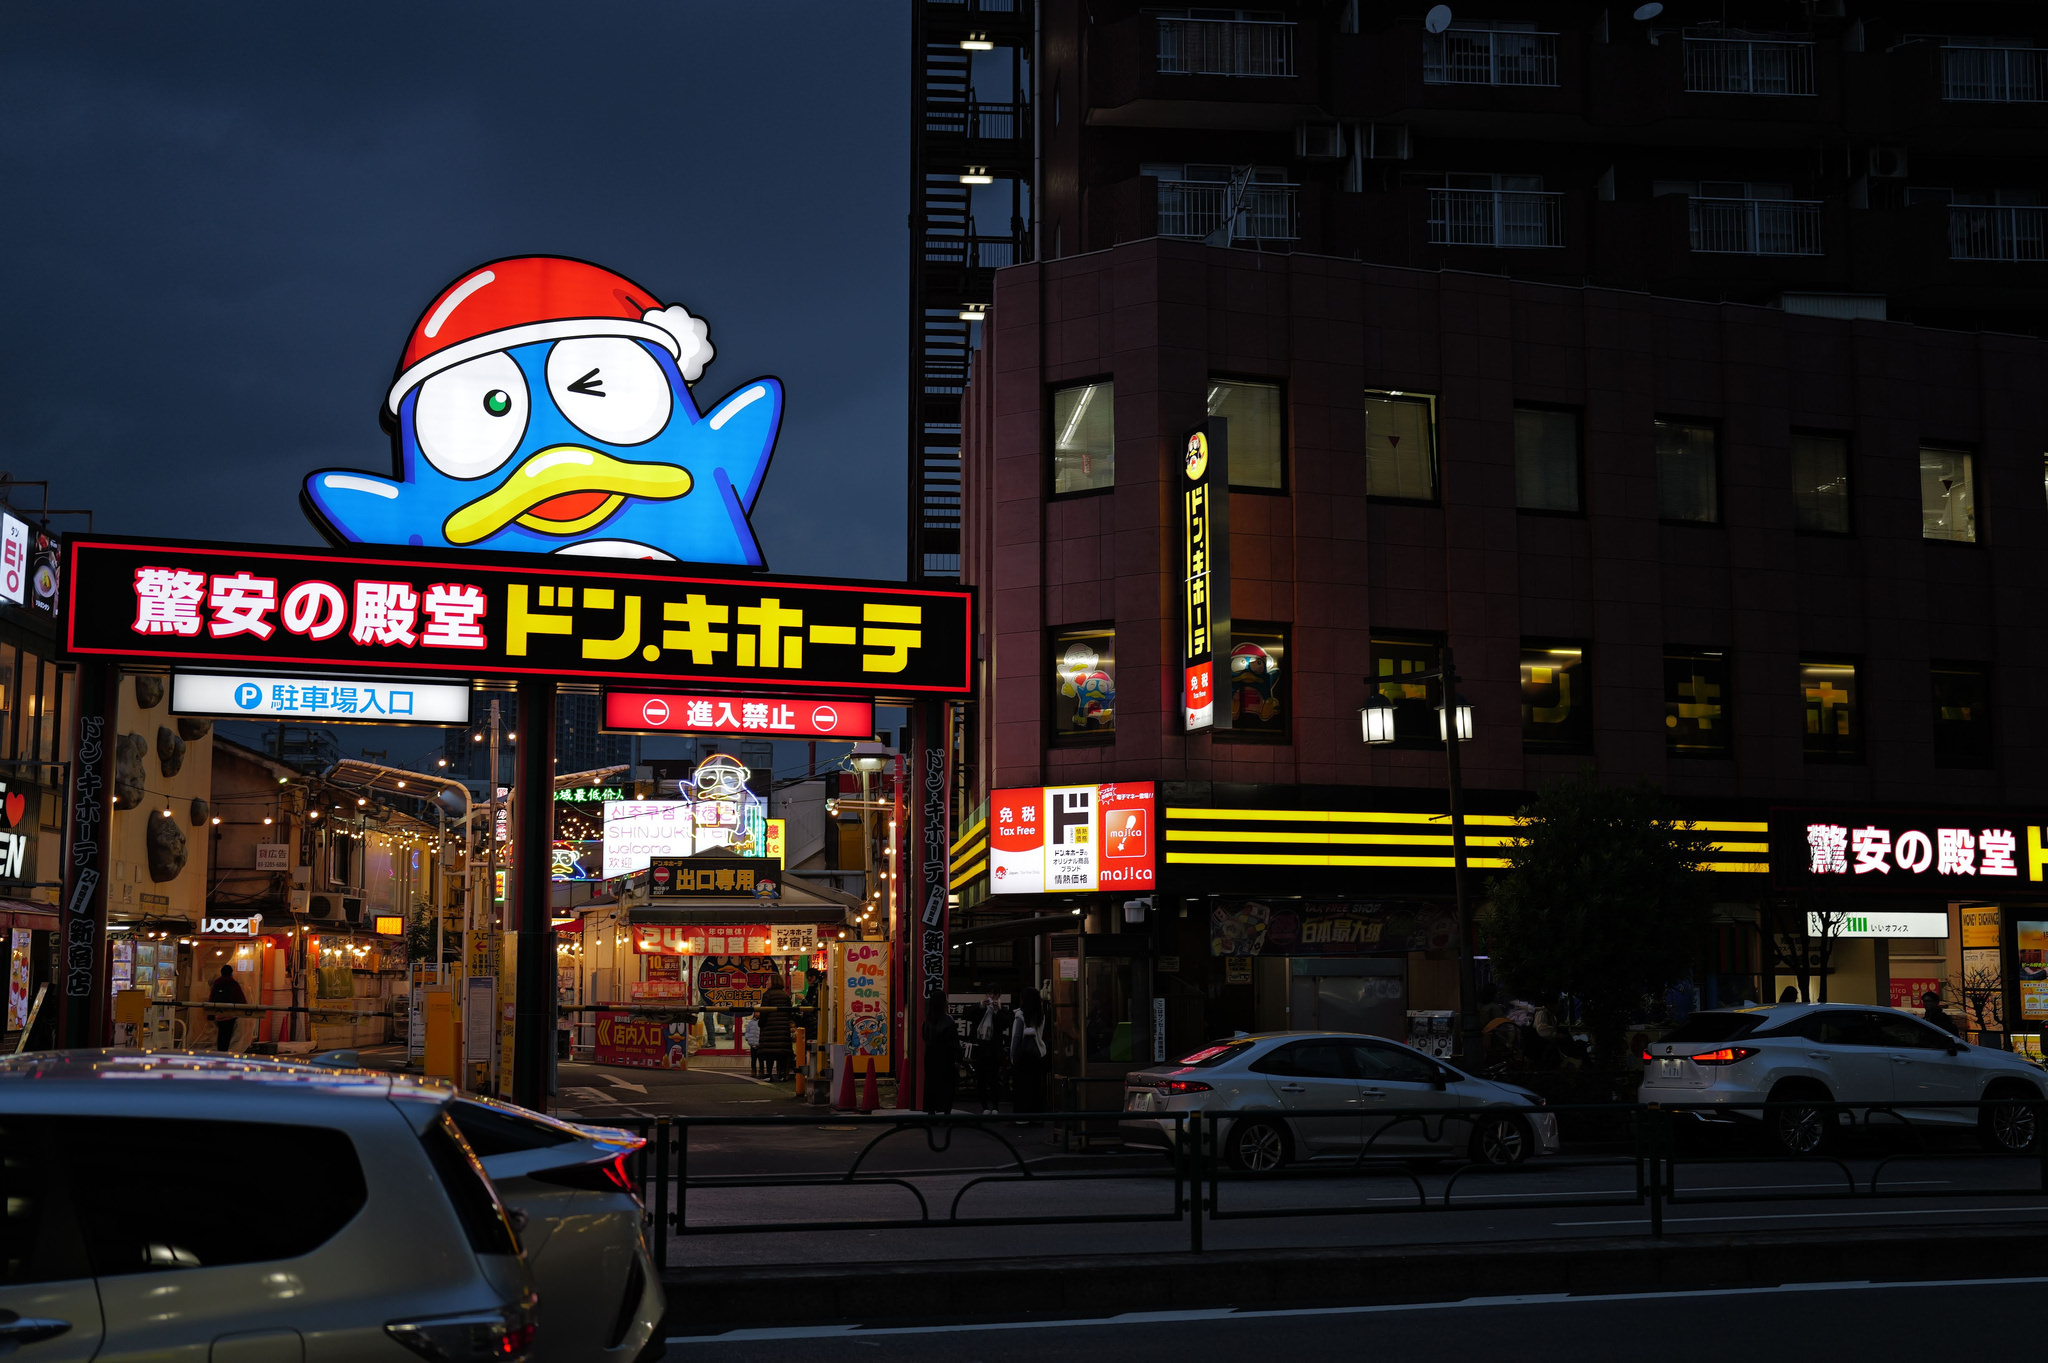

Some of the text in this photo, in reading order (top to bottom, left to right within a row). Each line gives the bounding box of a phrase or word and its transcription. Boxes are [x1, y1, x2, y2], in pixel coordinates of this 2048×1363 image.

[4, 538, 24, 593] 탕
[132, 567, 487, 649] 驚安の殿堂
[270, 684, 415, 716] 駐車場入口
[686, 699, 796, 730] 進入禁止
[999, 806, 1035, 823] 免税
[1053, 793, 1089, 844] ド
[1000, 826, 1035, 836] Tax Free
[609, 844, 671, 855] welcome
[1806, 824, 2018, 876] 驚安の殿堂
[1053, 857, 1089, 865] オリジナル商品
[676, 868, 755, 892] 出口専用
[1054, 874, 1087, 884] 情熱価格
[1352, 903, 1382, 912] SHOP
[1870, 924, 1908, 932] いいオフィス
[1963, 913, 1977, 926] MONEY
[473, 932, 489, 940] 入口
[1302, 919, 1384, 943] 日本最大級
[641, 927, 766, 954] 24時間営業
[777, 936, 813, 948] 新宿店
[66, 919, 95, 997] 新宿店
[847, 945, 879, 962] 60円
[856, 962, 885, 976] 70円
[701, 971, 731, 988] 出口
[847, 976, 874, 987] 80円
[855, 988, 880, 997] 90円
[612, 1025, 662, 1046] 店内入口
